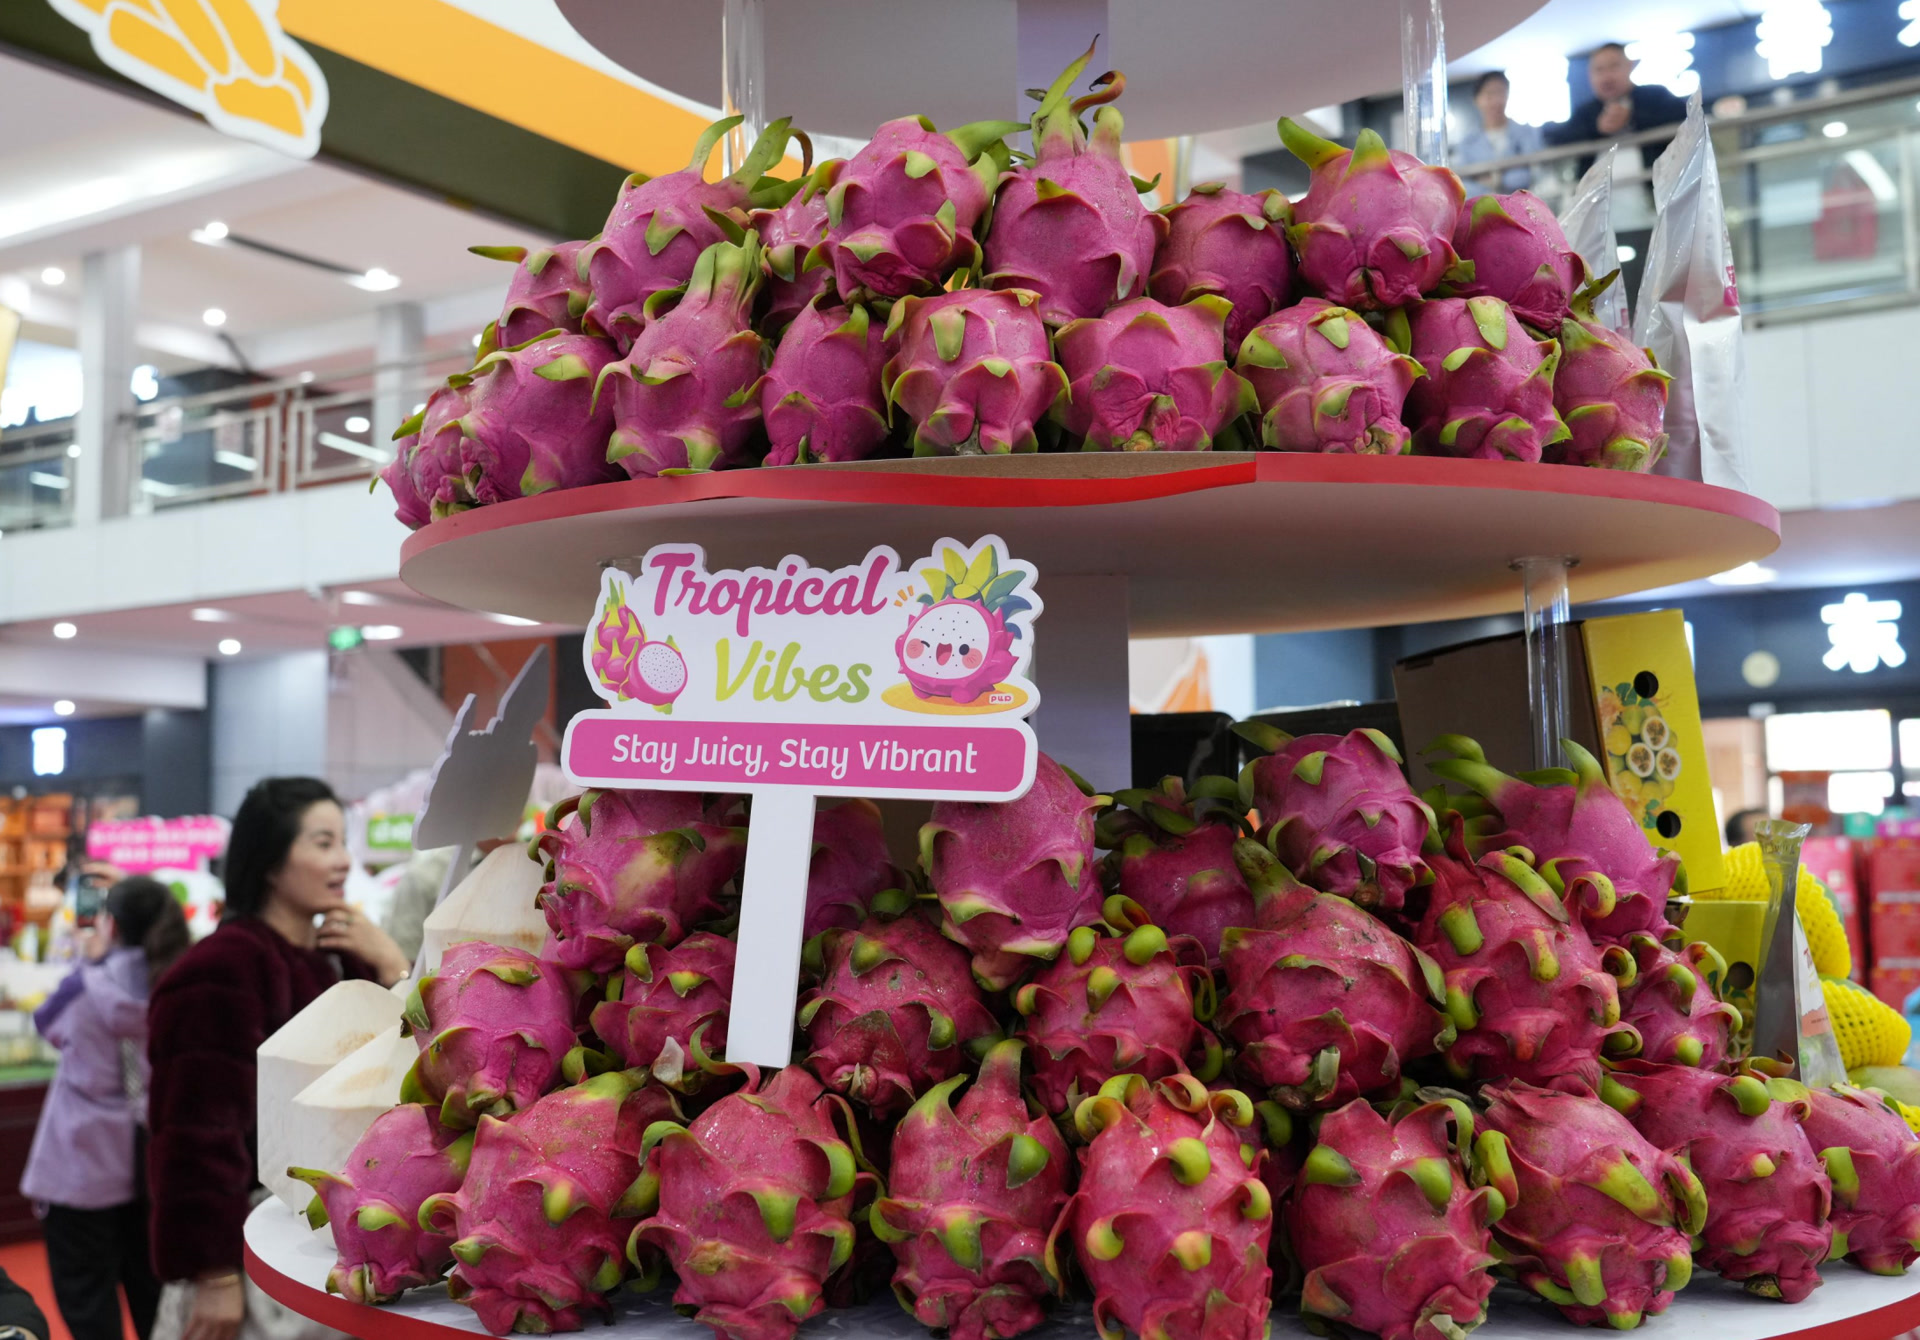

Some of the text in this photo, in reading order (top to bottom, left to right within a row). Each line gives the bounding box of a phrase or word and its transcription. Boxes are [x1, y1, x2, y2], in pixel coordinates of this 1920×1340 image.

[650, 552, 889, 637] Tropical
[715, 637, 872, 702] Vibes
[611, 734, 978, 781] Stay Juicy, Stay Vibrant
